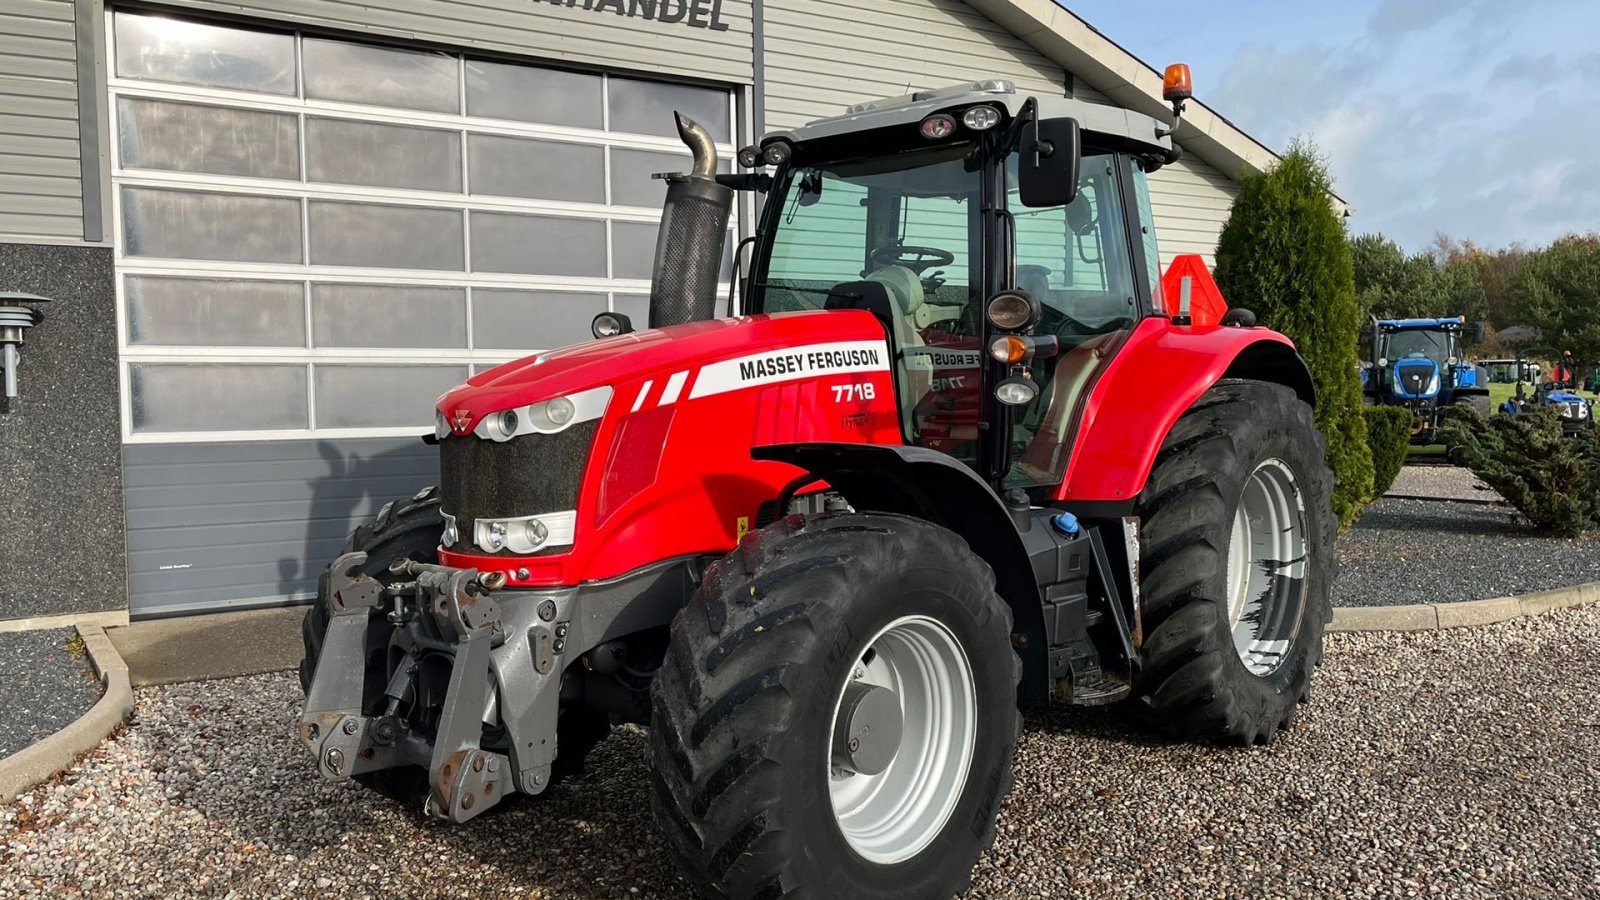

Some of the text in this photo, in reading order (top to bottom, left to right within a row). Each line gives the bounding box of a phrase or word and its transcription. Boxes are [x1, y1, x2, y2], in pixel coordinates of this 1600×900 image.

[739, 349, 879, 381] MASSEY FERGUSON
[831, 382, 876, 403] 7718
